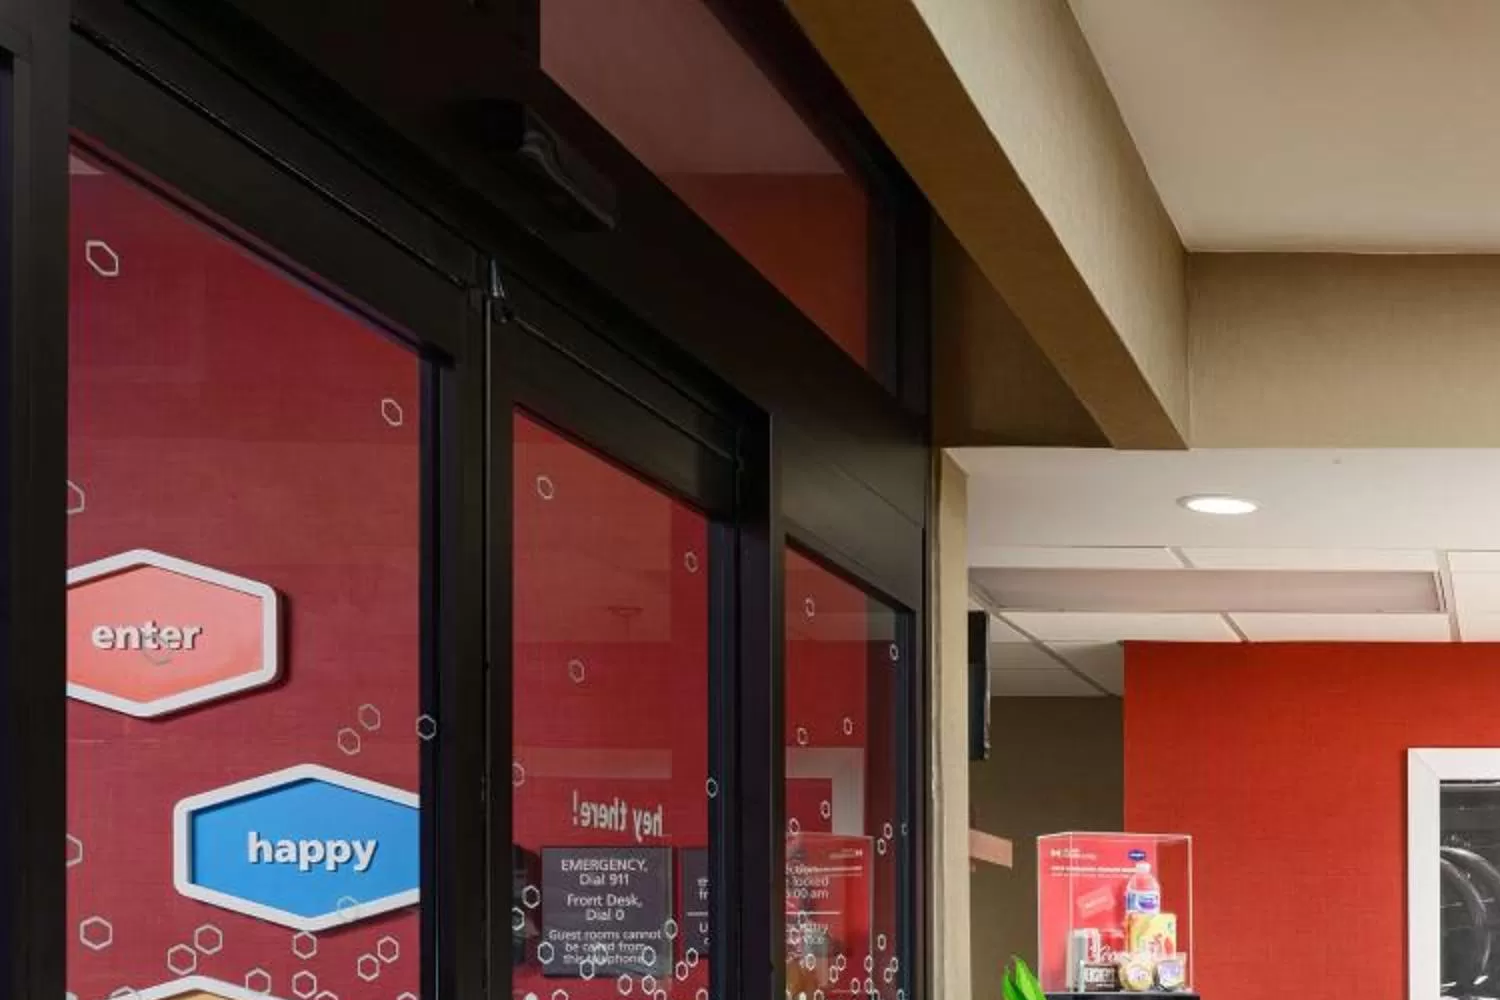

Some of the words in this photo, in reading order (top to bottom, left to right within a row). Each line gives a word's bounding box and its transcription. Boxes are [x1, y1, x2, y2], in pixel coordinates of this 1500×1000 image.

[92, 621, 203, 650] enter
[247, 831, 379, 872] happy
[579, 874, 605, 886] Dial
[609, 874, 629, 886] 911
[567, 894, 603, 907] Front
[586, 909, 611, 921] Dial
[549, 930, 581, 942] Guest
[586, 930, 620, 940] rooms
[623, 929, 661, 940] cannot
[583, 942, 615, 952] cad
